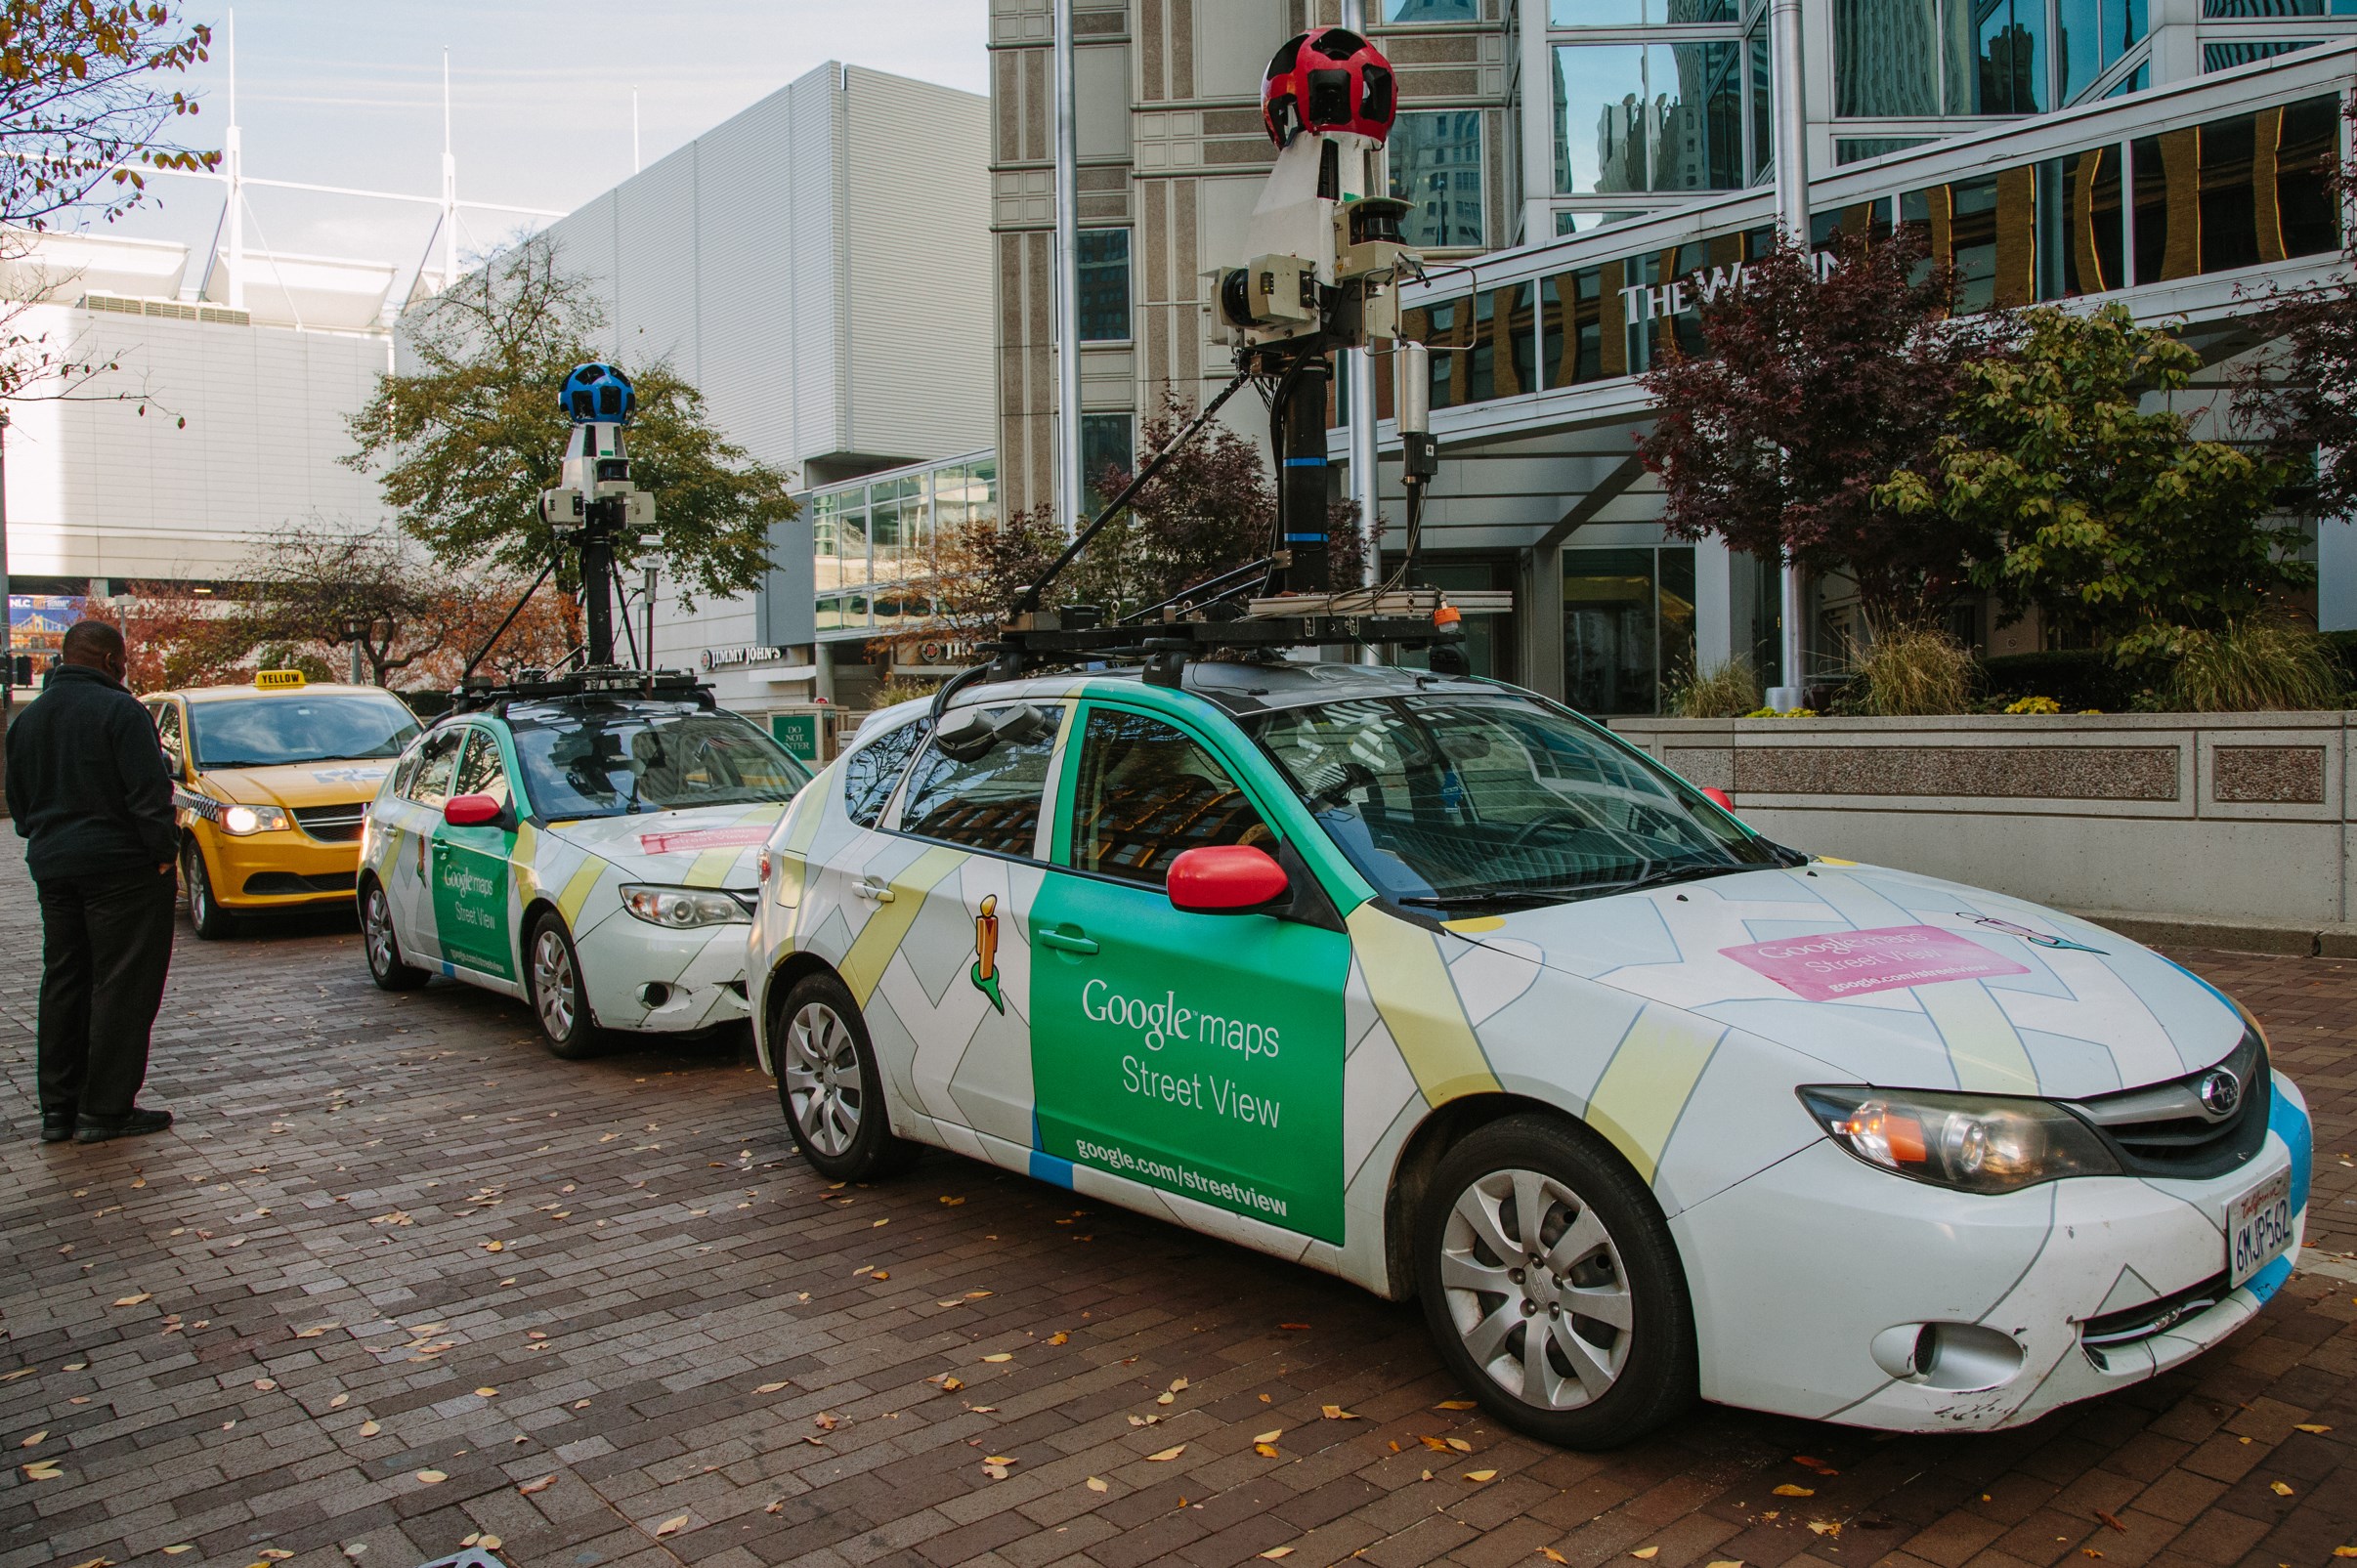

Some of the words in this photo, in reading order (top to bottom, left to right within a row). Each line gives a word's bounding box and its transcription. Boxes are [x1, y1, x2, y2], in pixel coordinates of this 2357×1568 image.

[1617, 281, 1693, 325] THE
[9, 598, 30, 608] NLC
[711, 649, 744, 668] JIMMY
[746, 647, 781, 664] JOHN'S
[262, 674, 299, 683] YELLOW
[445, 865, 472, 898] Google
[473, 877, 493, 898] maps
[455, 901, 477, 925] Street
[477, 907, 495, 929] View
[1758, 938, 1860, 958] Google
[1863, 933, 1929, 946] maps
[1805, 954, 1883, 973] Street
[1884, 948, 1943, 962] View
[1828, 965, 1991, 993] google.com/streetview
[1082, 979, 1192, 1051] Google
[1200, 1013, 1279, 1061] maps
[1123, 1055, 1203, 1110] Street
[1209, 1075, 1280, 1128] View
[1076, 1139, 1287, 1217] google.com/streetview
[2237, 1200, 2290, 1272] 6MJP562
